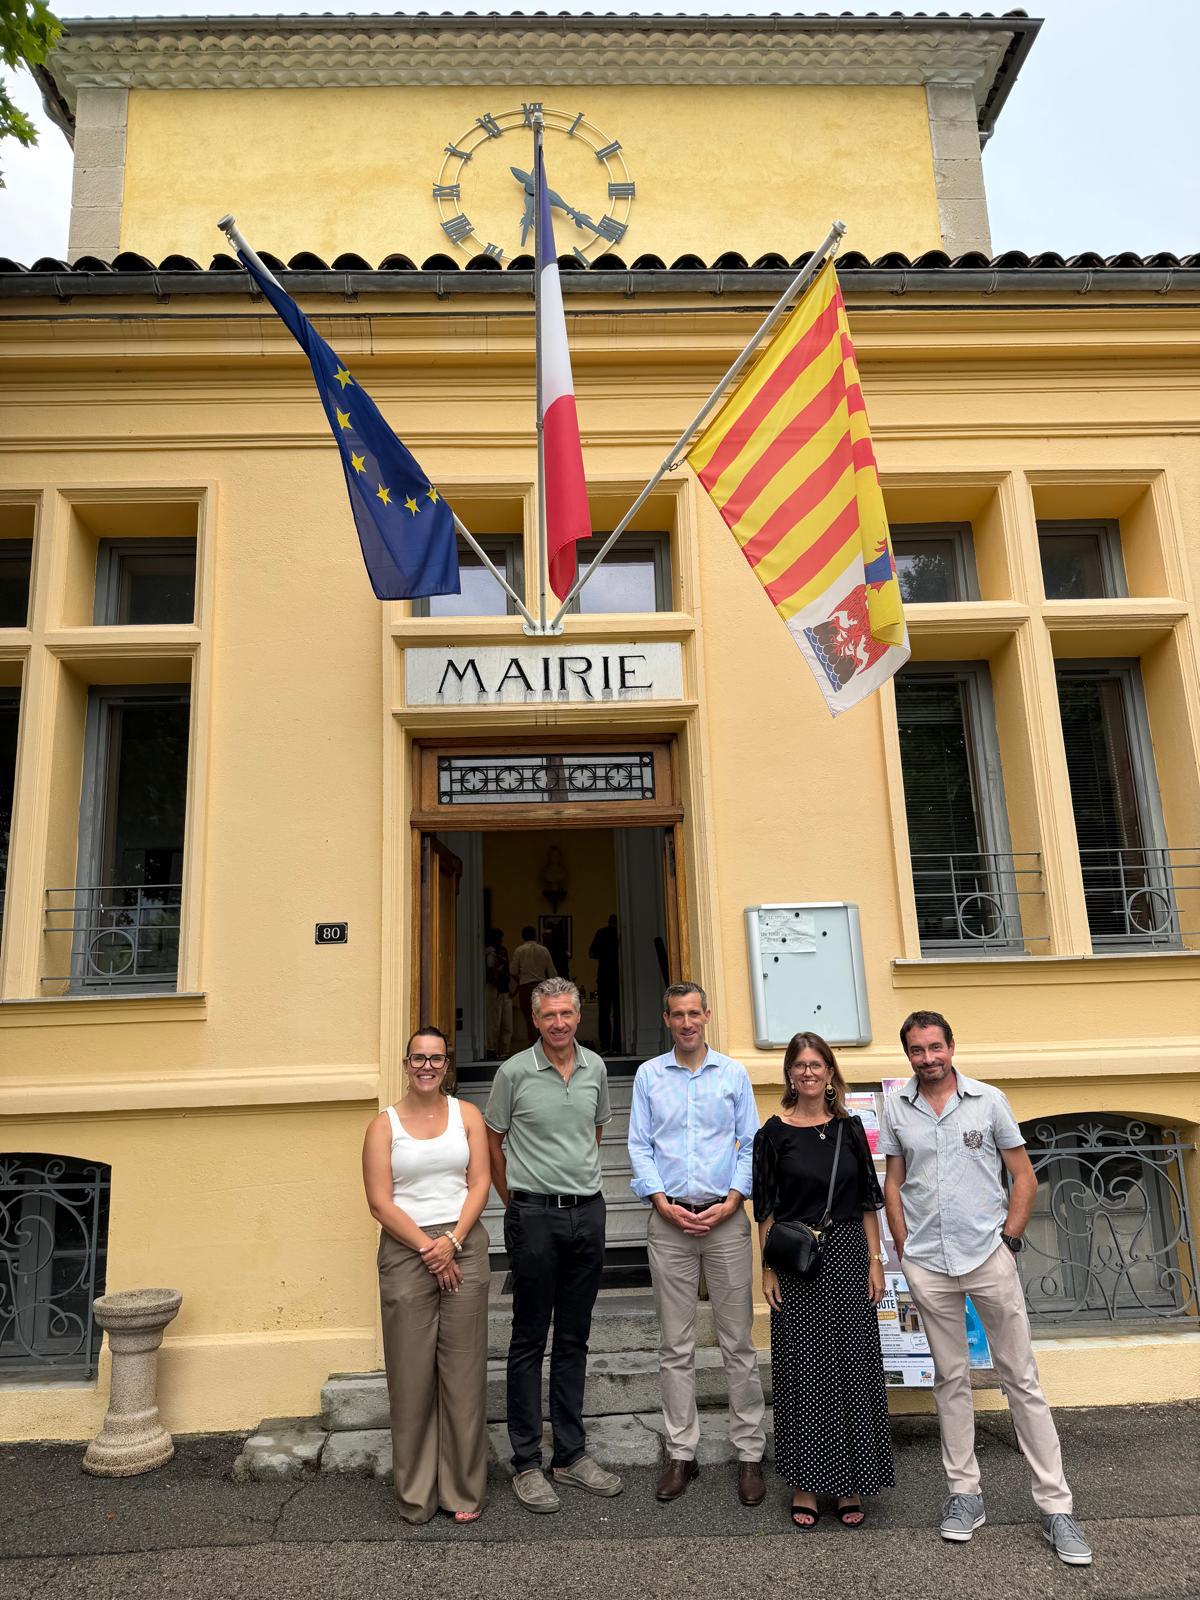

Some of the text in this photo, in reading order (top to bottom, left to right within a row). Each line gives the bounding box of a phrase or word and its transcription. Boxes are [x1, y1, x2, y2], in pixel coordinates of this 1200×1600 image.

[444, 142, 473, 161] X
[594, 139, 623, 161] II
[433, 182, 461, 200] IX
[608, 181, 635, 199] III
[440, 213, 475, 245] VIII
[435, 655, 653, 698] MAIRIE
[323, 927, 340, 939] 80
